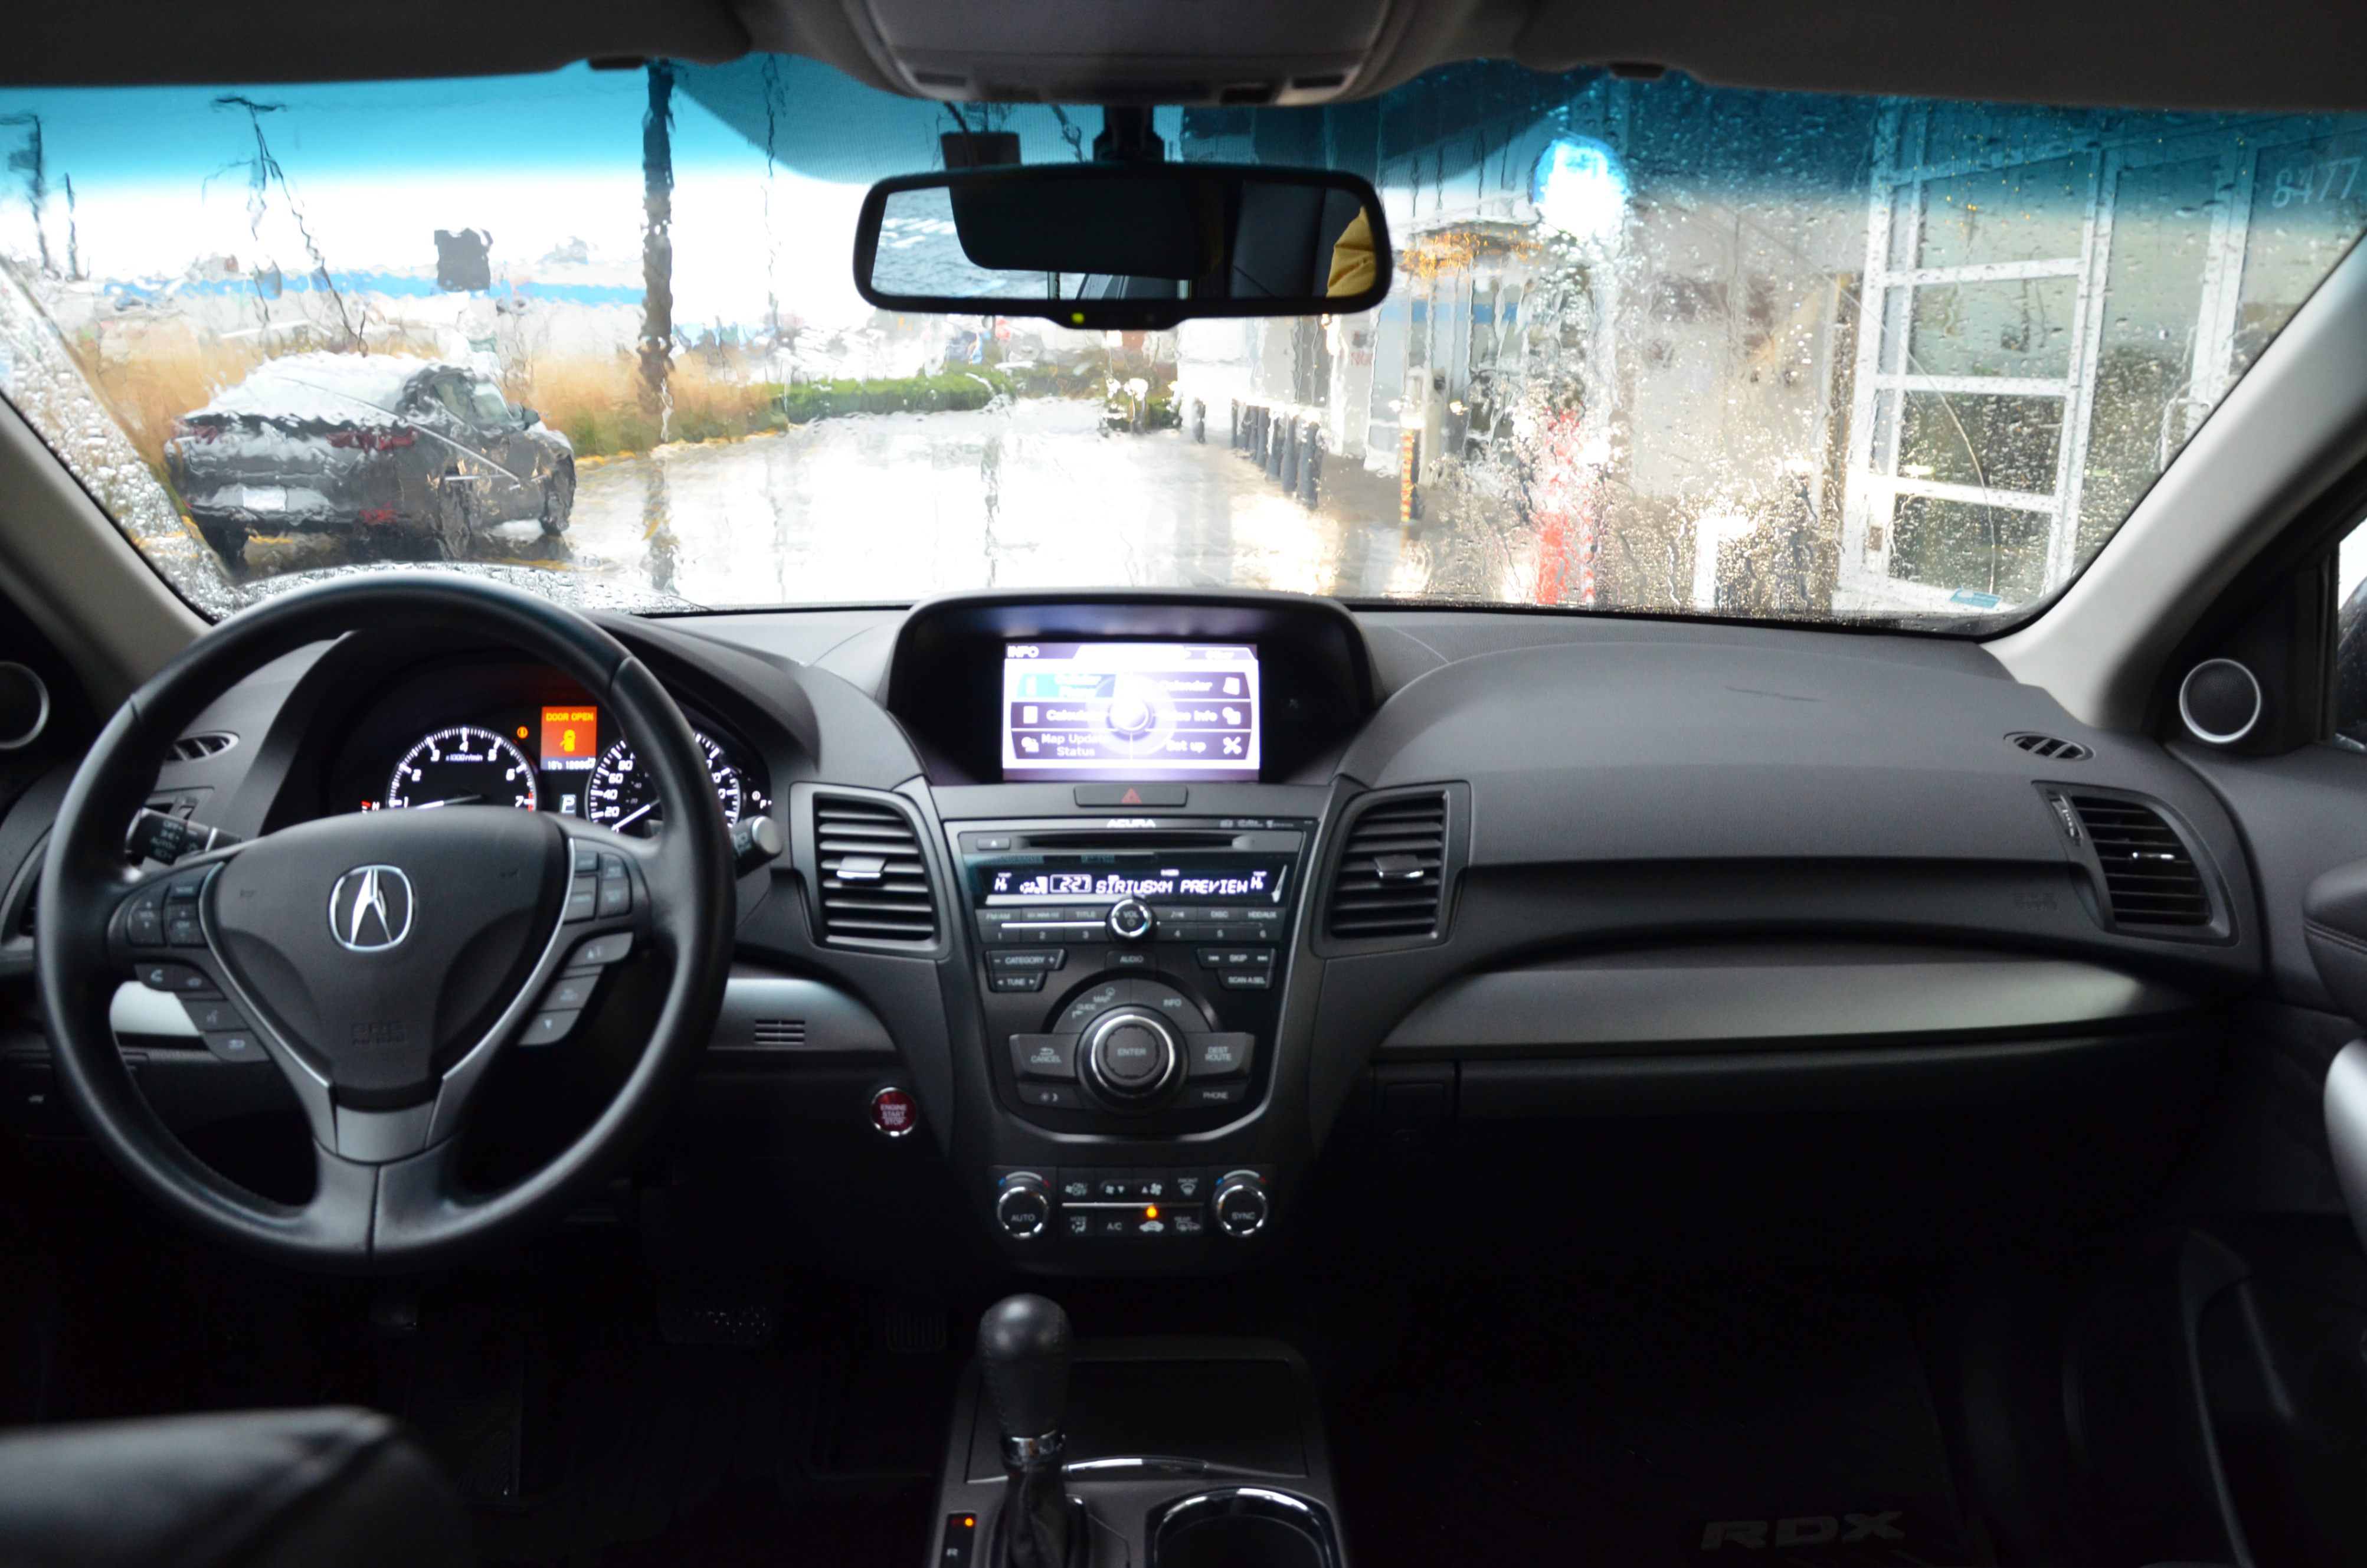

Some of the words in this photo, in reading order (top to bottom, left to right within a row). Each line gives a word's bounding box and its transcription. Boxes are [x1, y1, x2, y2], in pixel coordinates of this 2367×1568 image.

[1007, 646, 1039, 658] INFO
[546, 712, 569, 721] DOOR
[571, 712, 594, 721] OPEN
[1042, 734, 1065, 745] Map
[1068, 734, 1111, 745] Update
[459, 741, 469, 752] 4
[430, 749, 440, 762] 3
[487, 748, 497, 761] 5
[1057, 746, 1095, 757] Status
[618, 760, 633, 771] 80
[411, 769, 421, 781] 2
[506, 768, 515, 781] 6
[608, 773, 623, 784] 60
[603, 789, 618, 800] 40
[404, 796, 409, 808] 1
[515, 795, 524, 808] 7
[561, 796, 576, 814] P
[605, 807, 620, 817] 20
[1106, 819, 1156, 828] ACURA
[1095, 880, 1173, 894] SIRIUSXM
[1180, 880, 1248, 894] PREVIEW
[998, 932, 1002, 940] 1
[1039, 931, 1046, 940] 2
[1082, 930, 1089, 939] 3
[1174, 929, 1181, 938] 4
[1216, 929, 1224, 938] 5
[1259, 929, 1266, 938] 6
[1004, 956, 1046, 964] CATEGORY
[1229, 954, 1248, 963] SKIP
[1006, 978, 1026, 986] TUNE
[1163, 999, 1183, 1007] INFO
[1117, 1048, 1147, 1056] ENTER
[1030, 1055, 1062, 1063] CANCEL
[1204, 1053, 1232, 1061] ROUTE
[1202, 1091, 1229, 1099] PHONE
[1011, 1213, 1035, 1222] AUTO
[1231, 1212, 1256, 1220] SYNC
[1106, 1222, 1123, 1231] A/C
[1700, 1510, 1906, 1551] RDX
